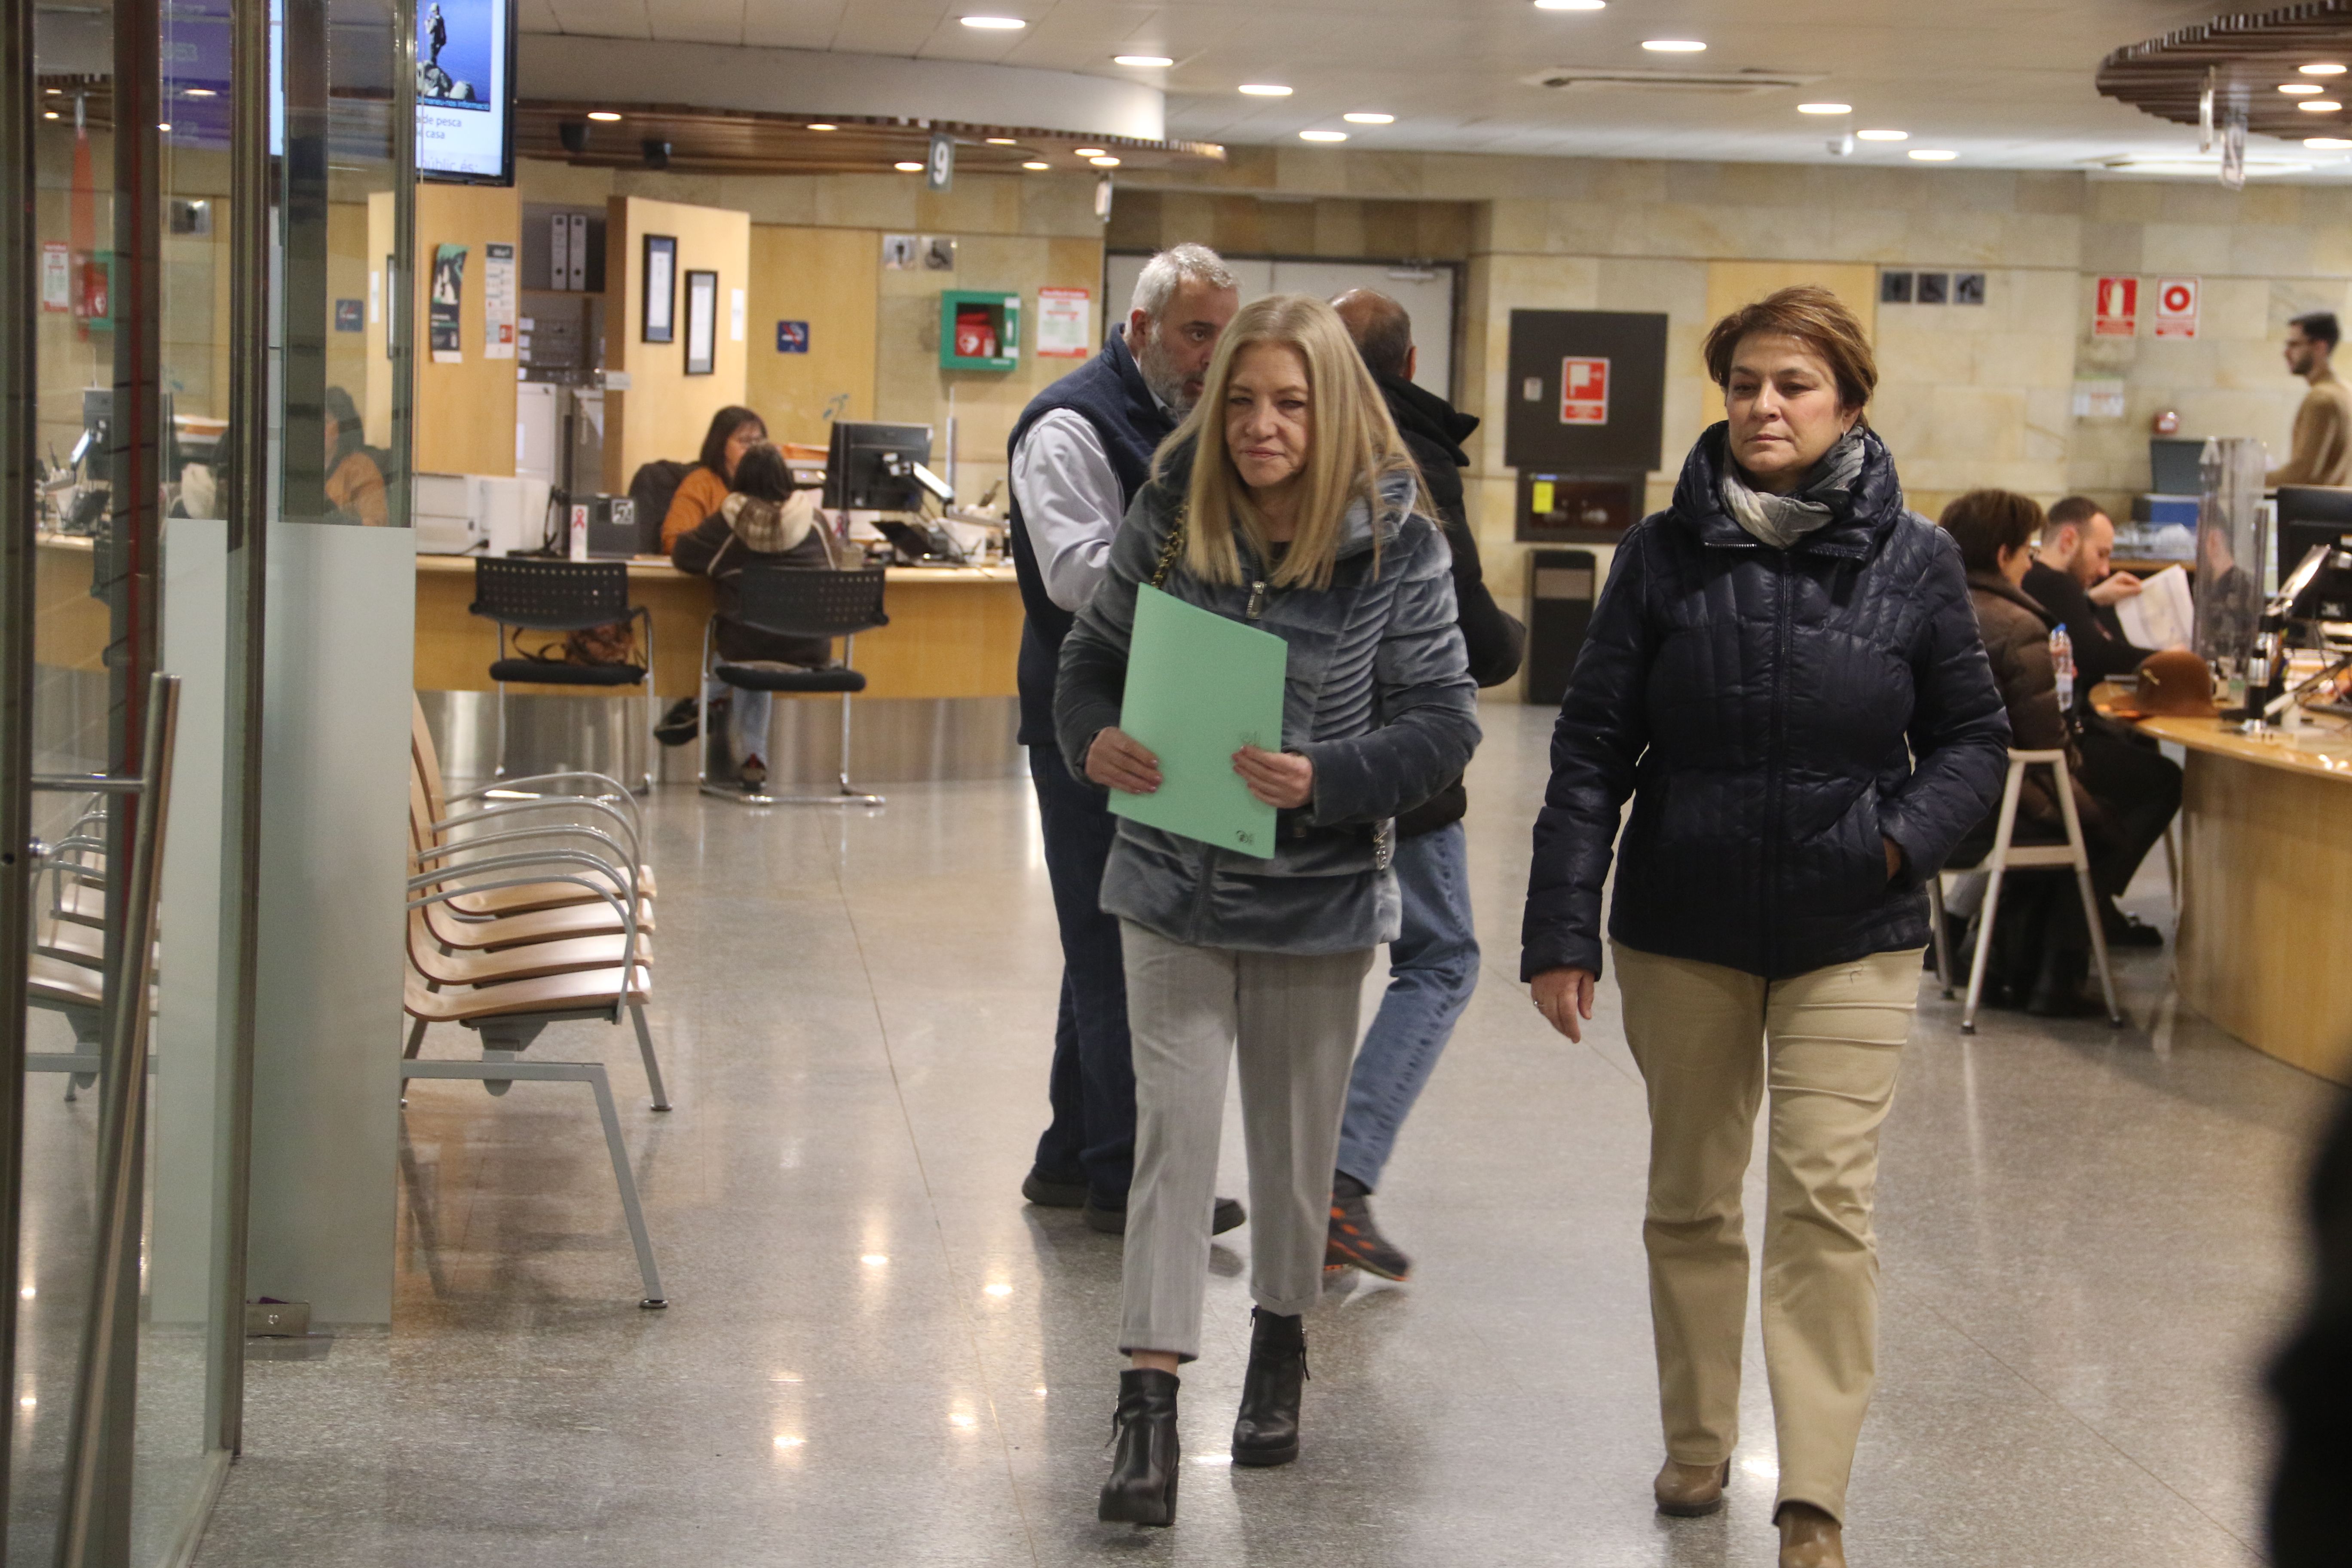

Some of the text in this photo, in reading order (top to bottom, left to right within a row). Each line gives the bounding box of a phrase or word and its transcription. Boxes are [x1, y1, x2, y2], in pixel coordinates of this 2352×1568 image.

[436, 117, 462, 127] pesca
[426, 130, 445, 139] casa
[933, 141, 949, 184] 9
